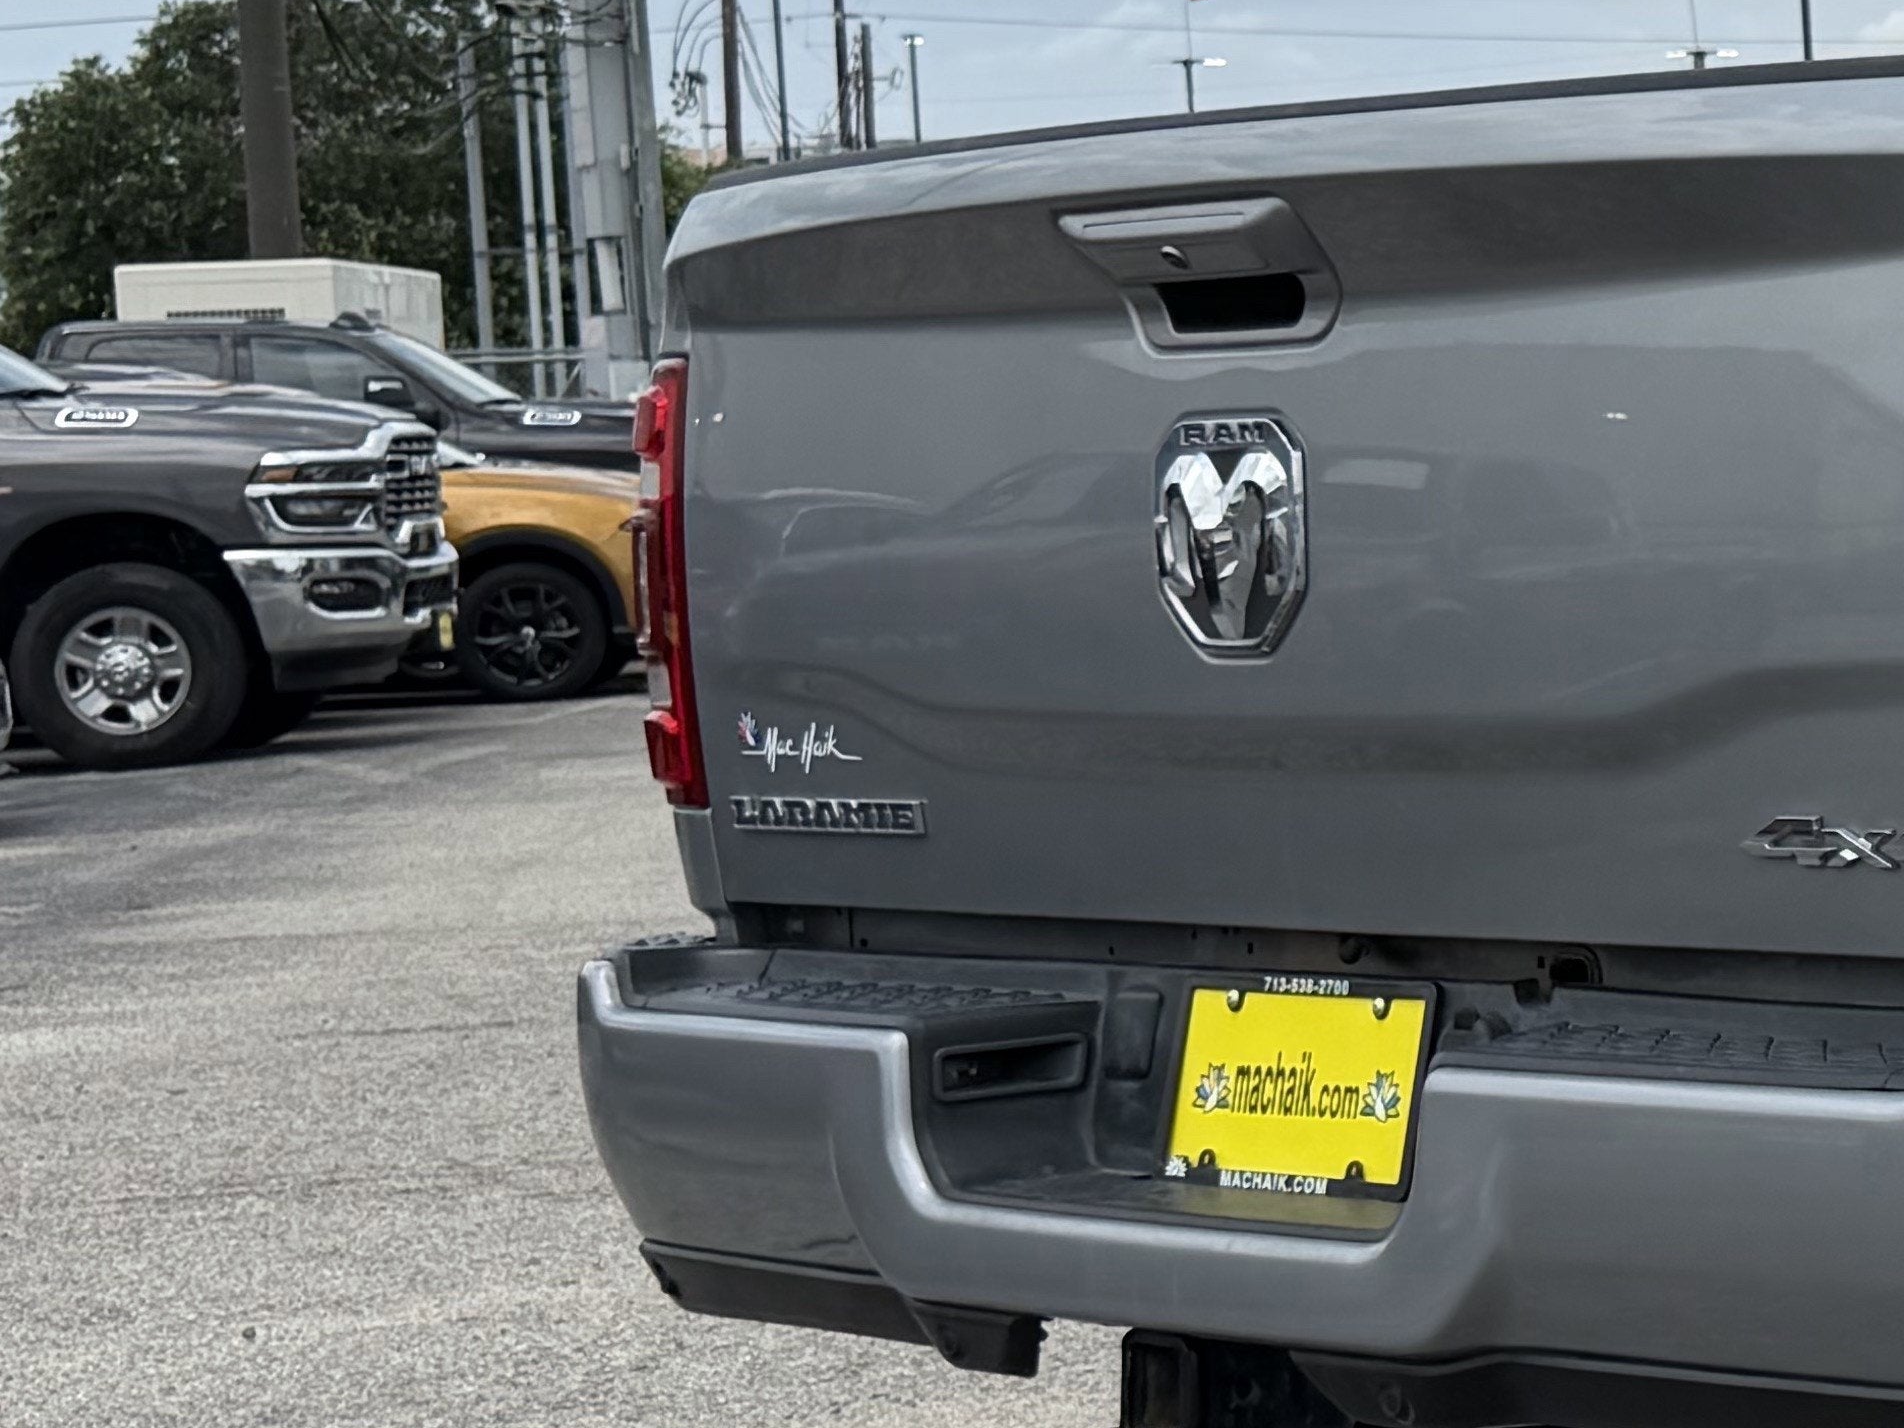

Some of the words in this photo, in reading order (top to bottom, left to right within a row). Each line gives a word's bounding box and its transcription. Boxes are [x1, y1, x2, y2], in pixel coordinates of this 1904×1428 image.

[1179, 420, 1266, 447] RAM
[741, 726, 800, 773] Mac
[801, 722, 863, 774] Haik
[729, 795, 928, 835] LARAMIE
[1231, 1051, 1361, 1119] machaik.com
[1219, 1169, 1328, 1195] MACHAIK.COM
